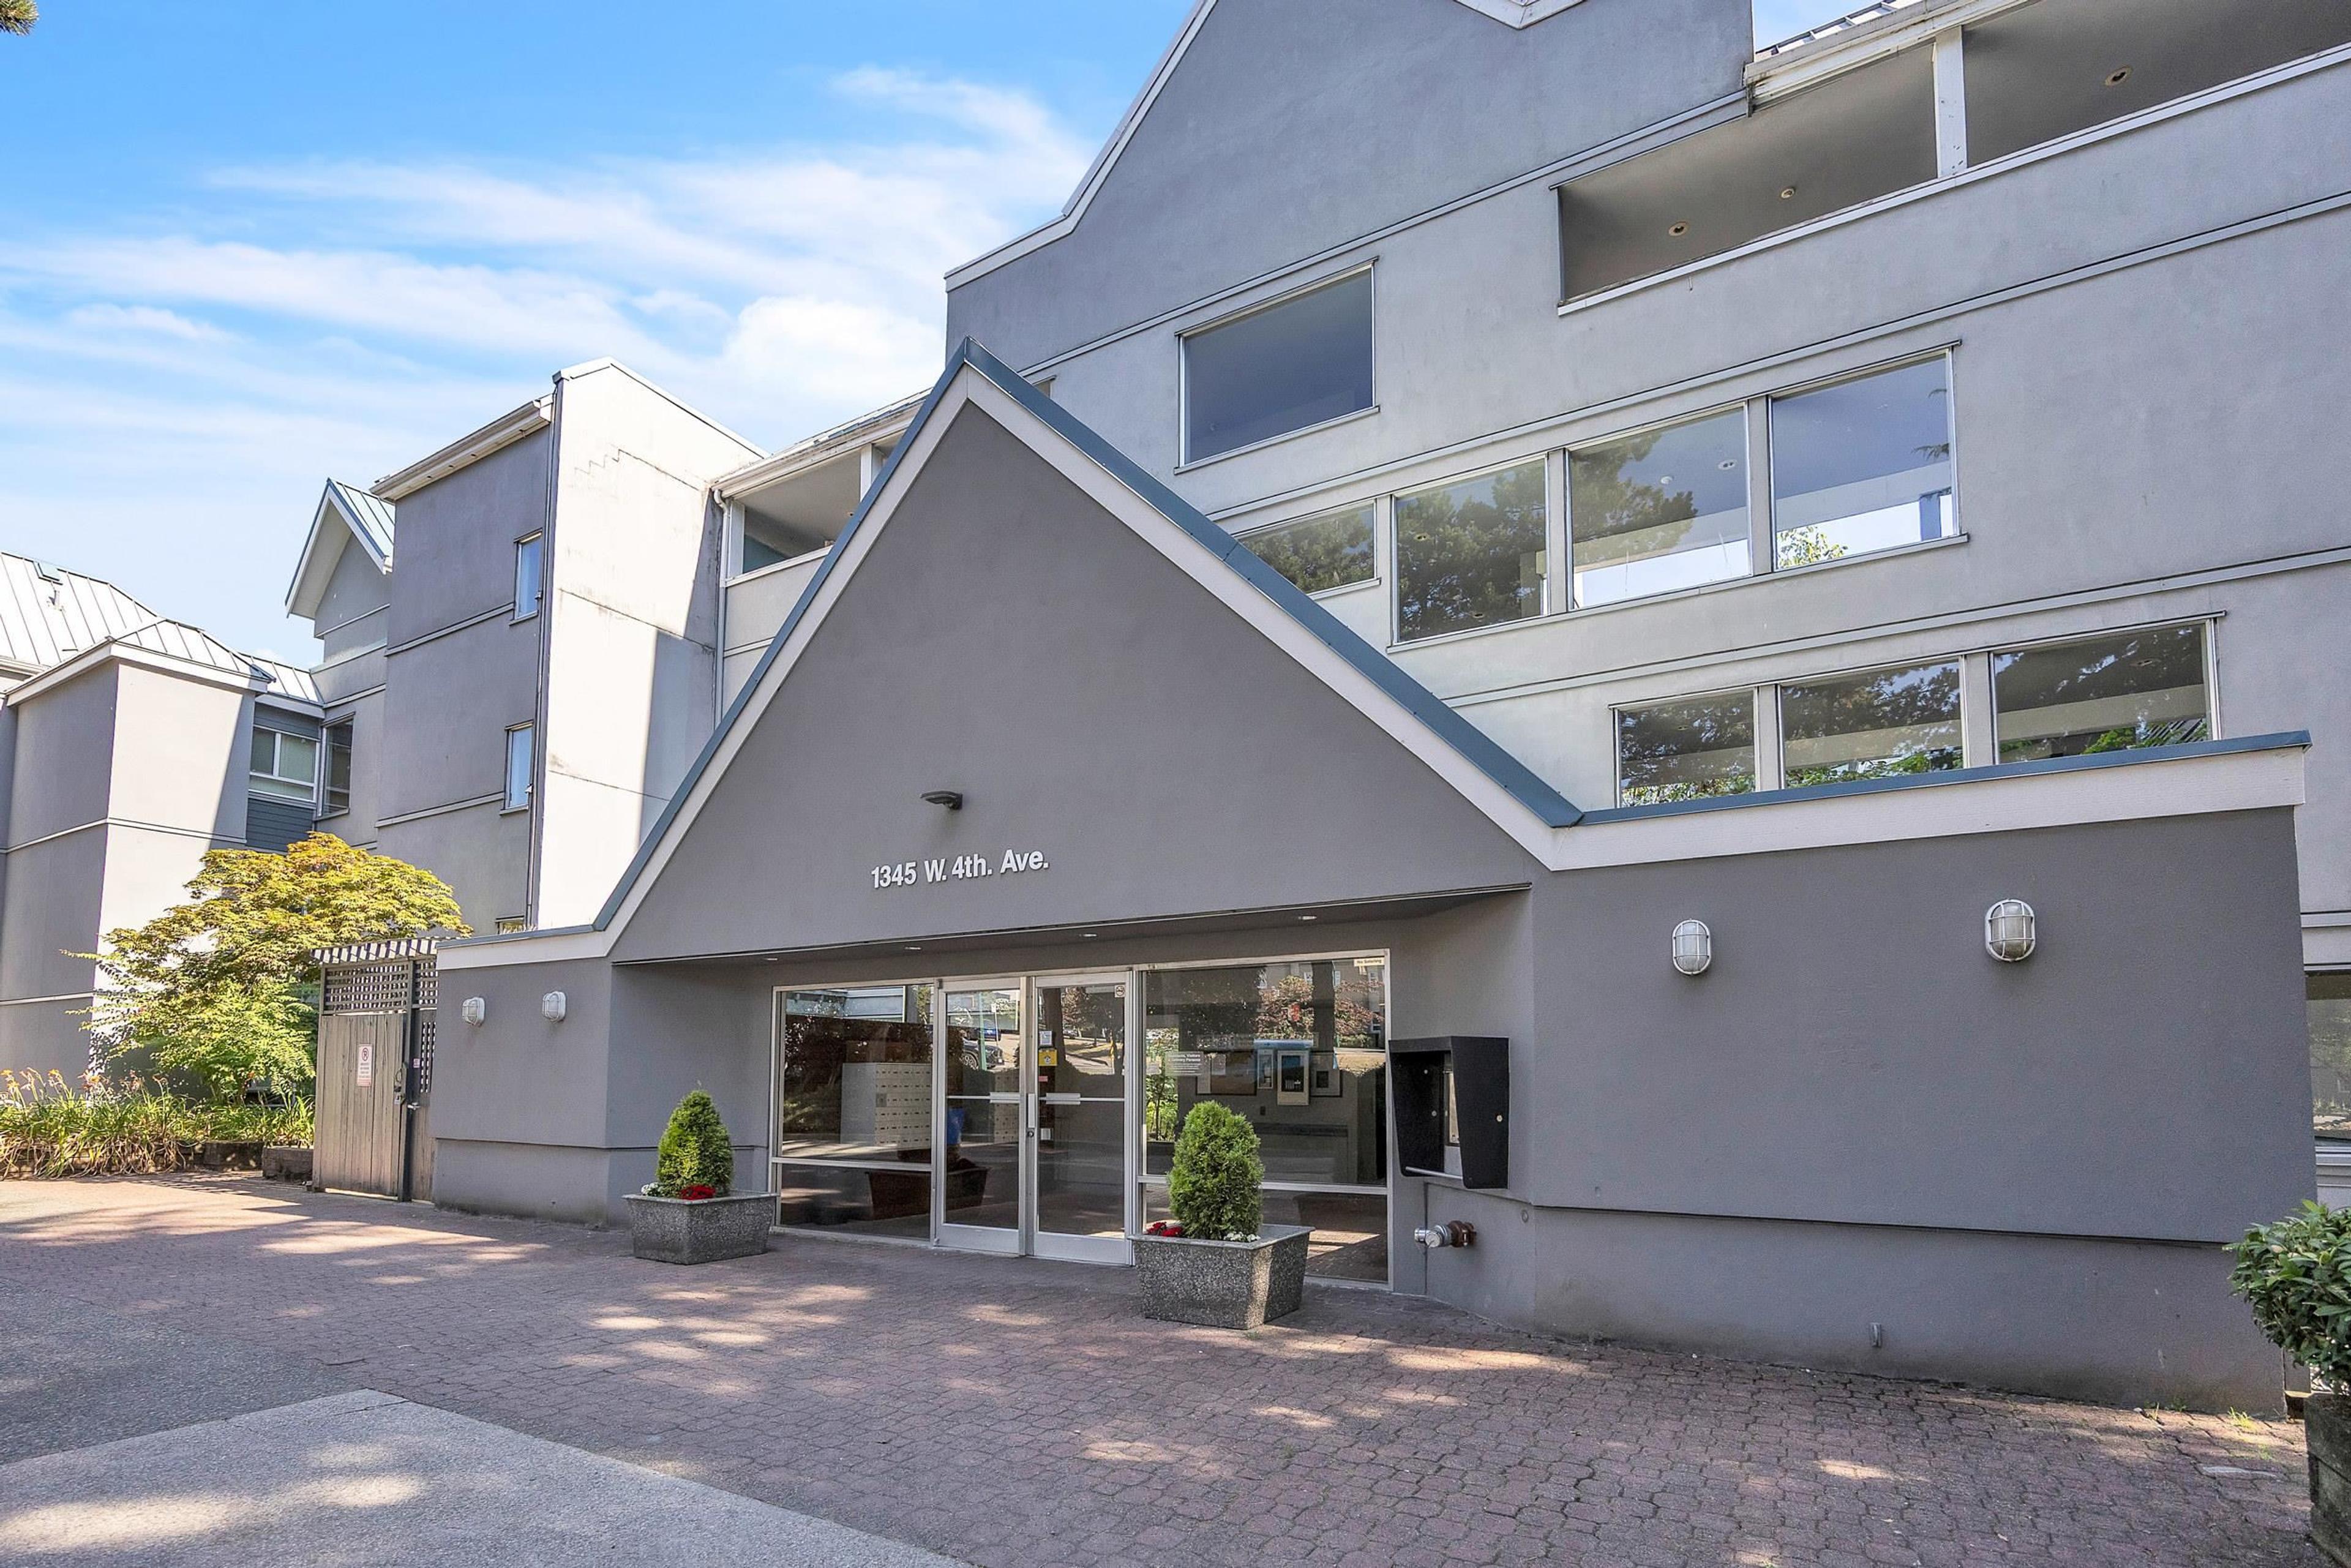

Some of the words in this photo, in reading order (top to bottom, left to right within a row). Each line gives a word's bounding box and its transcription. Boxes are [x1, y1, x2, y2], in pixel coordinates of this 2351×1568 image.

[871, 861, 917, 888] 1345
[924, 858, 947, 882] W.
[951, 853, 992, 879] 4th.
[1000, 849, 1049, 873] Ave.
